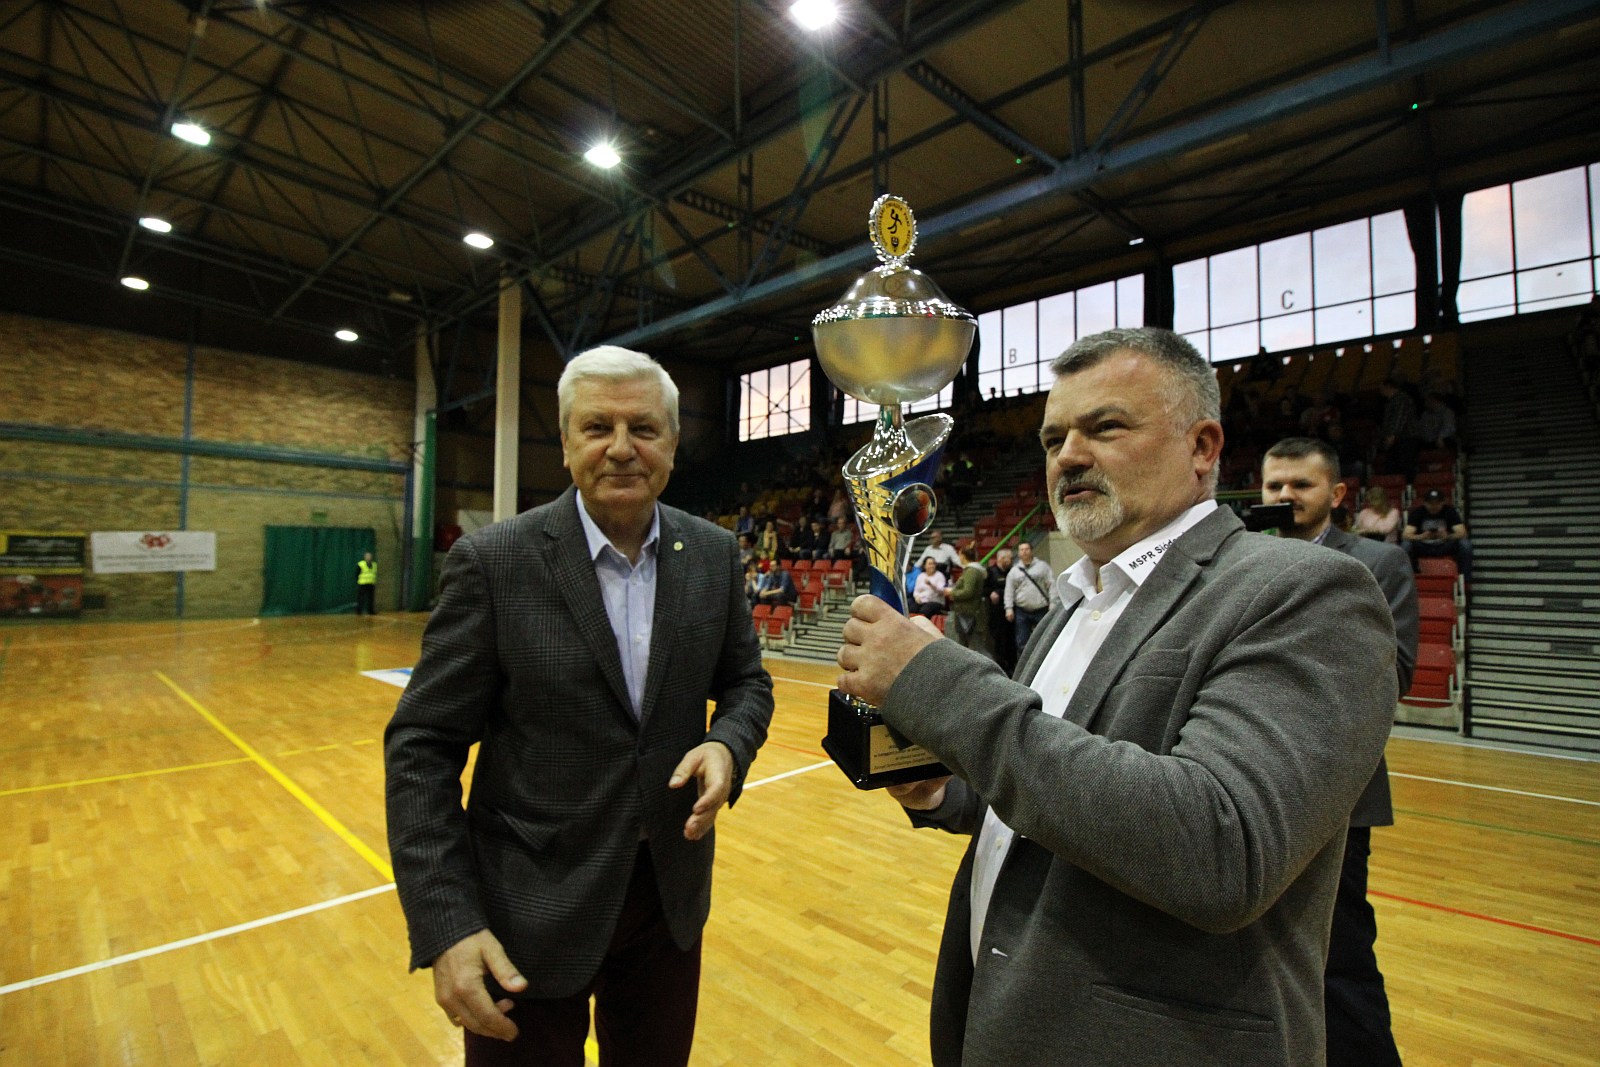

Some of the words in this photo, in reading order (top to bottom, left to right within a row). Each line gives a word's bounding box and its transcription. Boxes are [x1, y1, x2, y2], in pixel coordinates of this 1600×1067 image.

[1281, 290, 1294, 310] C
[1009, 348, 1017, 364] B
[1128, 550, 1156, 570] MSPR
